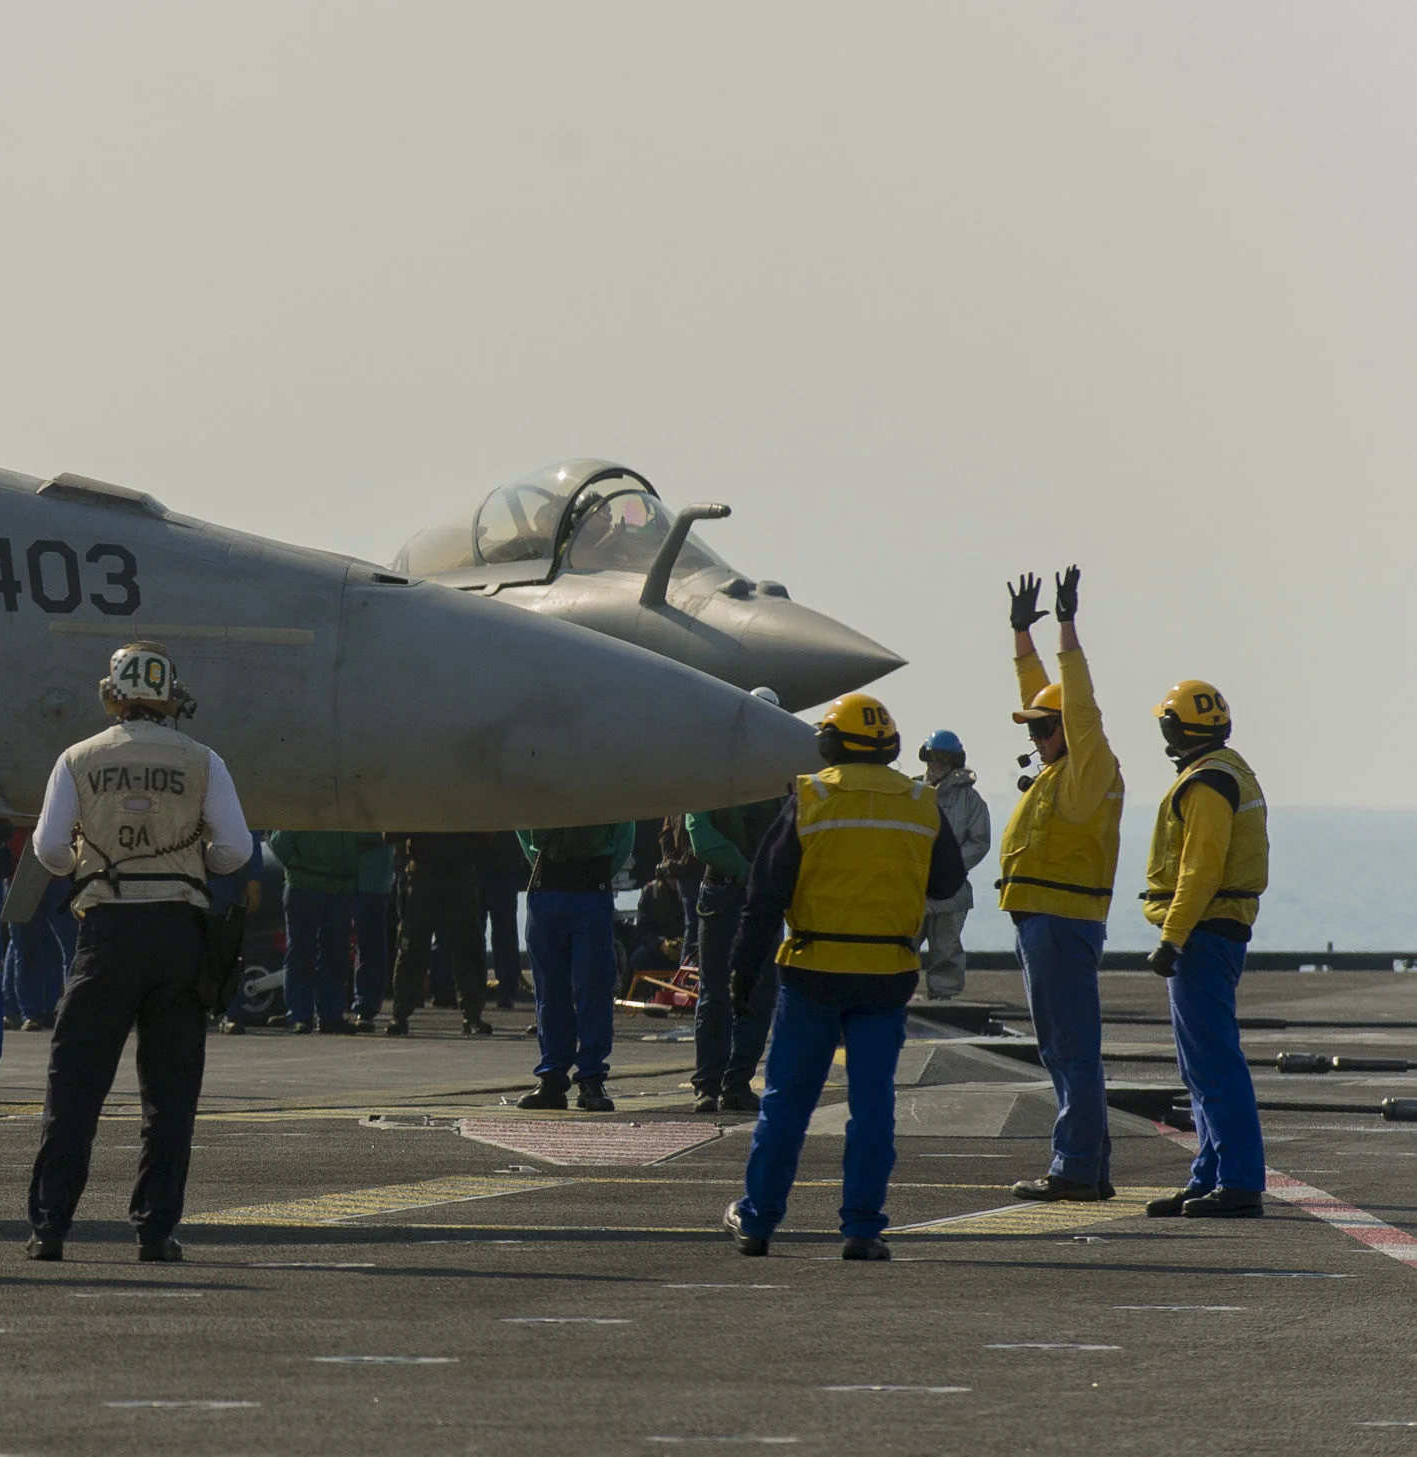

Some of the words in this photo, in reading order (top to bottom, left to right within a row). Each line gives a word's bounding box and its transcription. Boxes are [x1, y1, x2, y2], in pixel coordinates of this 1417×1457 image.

[119, 656, 166, 697] 4Q
[862, 707, 889, 726] DC
[87, 767, 186, 796] VFA-105
[118, 824, 151, 851] QA
